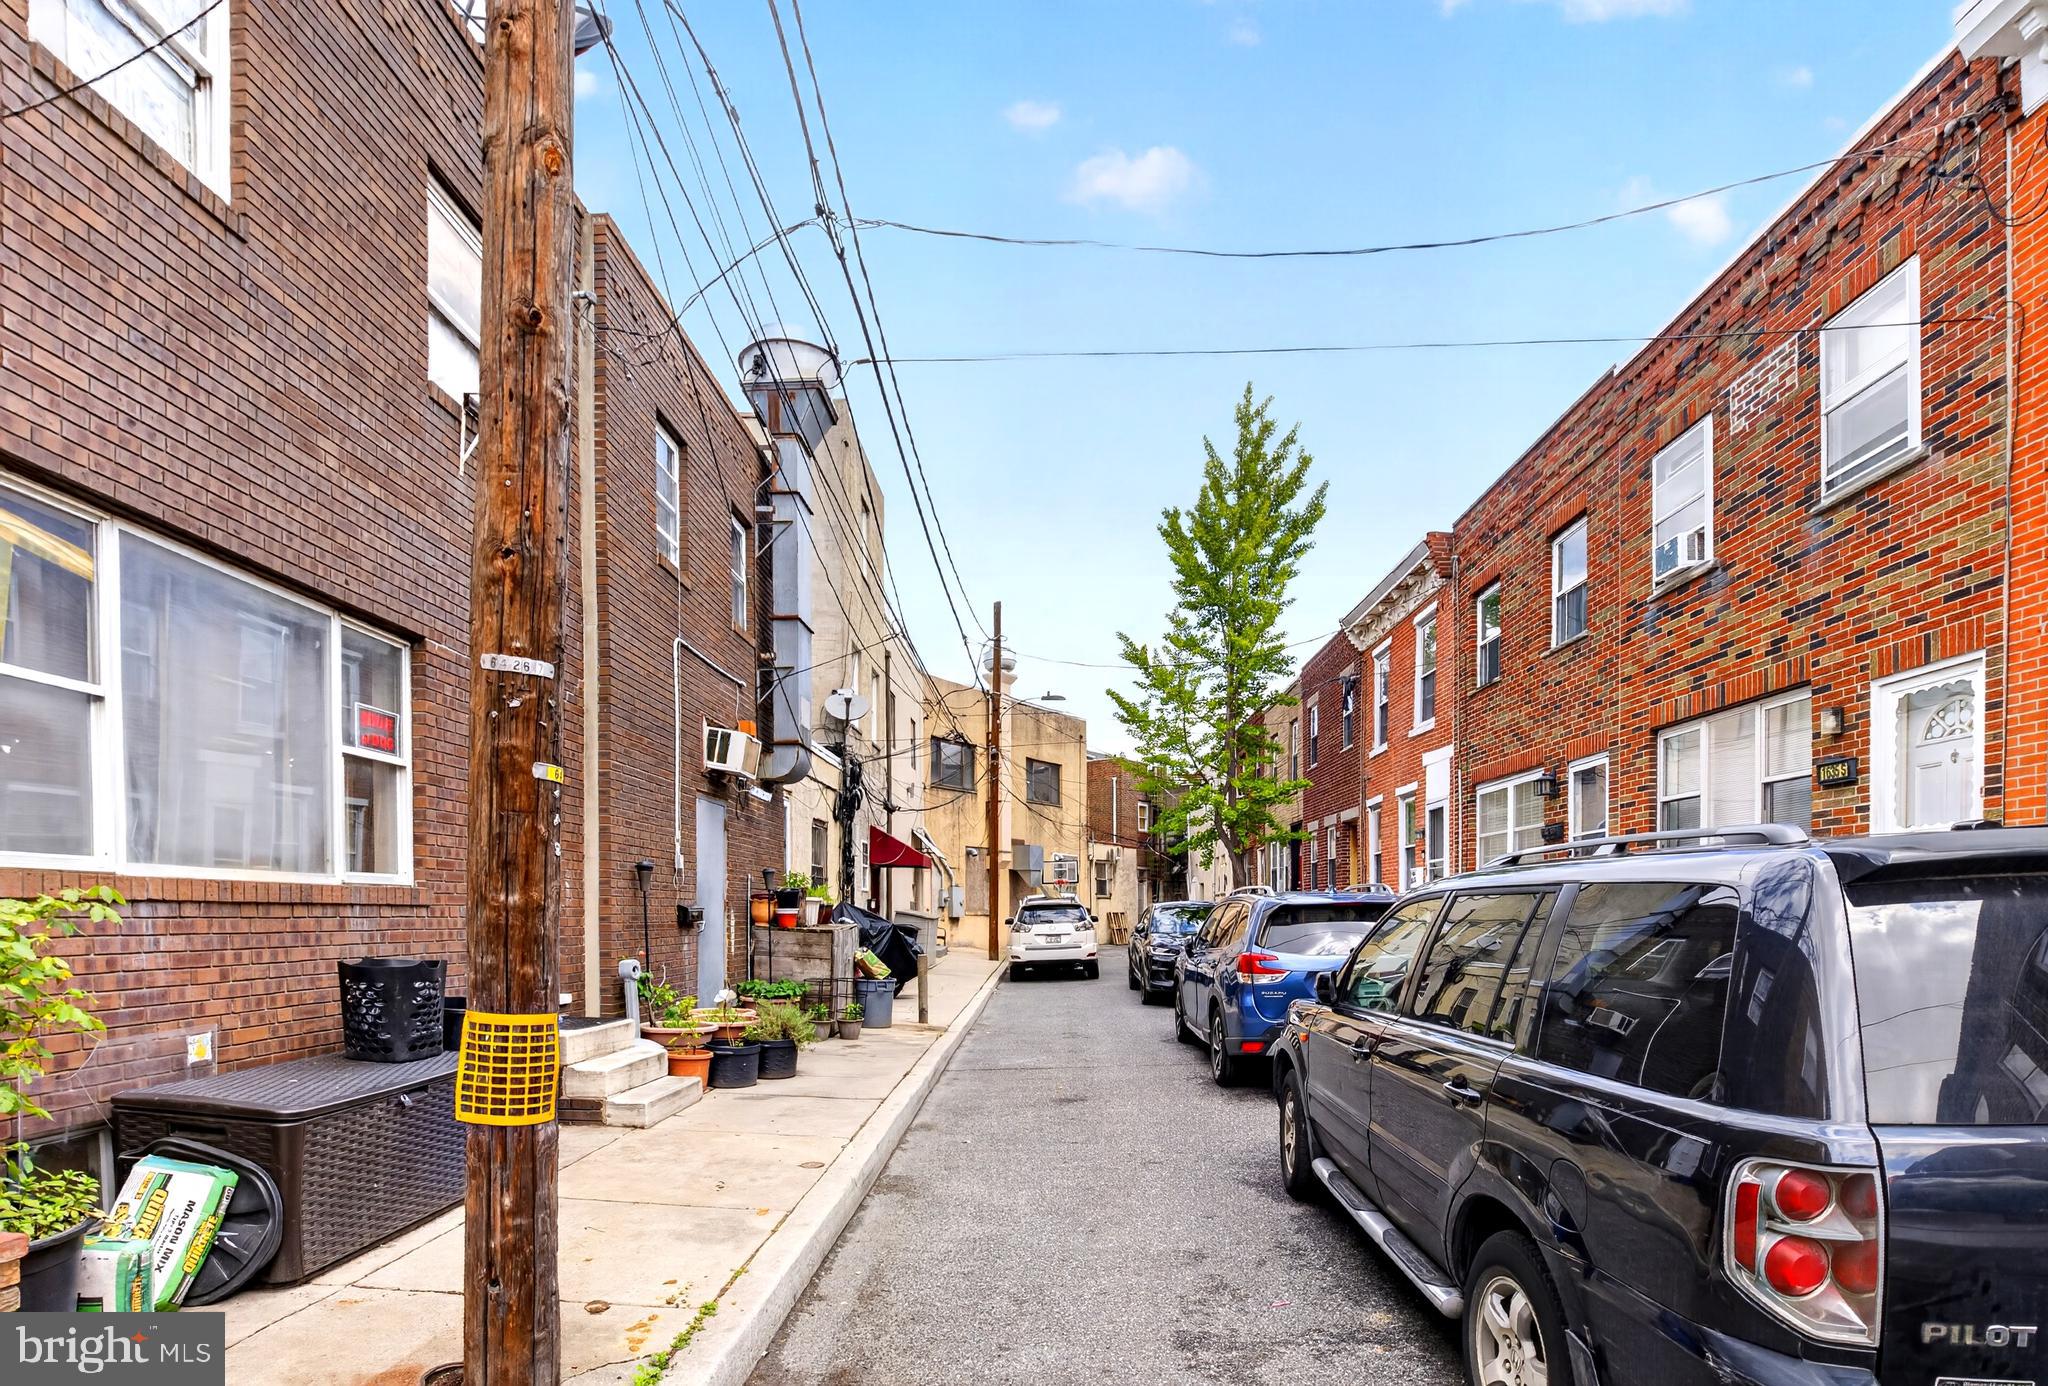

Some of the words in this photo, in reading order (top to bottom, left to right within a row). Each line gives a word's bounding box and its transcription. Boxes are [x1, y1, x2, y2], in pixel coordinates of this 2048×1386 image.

[170, 1200, 196, 1244] MASON
[155, 1247, 174, 1274] MIX
[1921, 1322, 2038, 1348] PILOT
